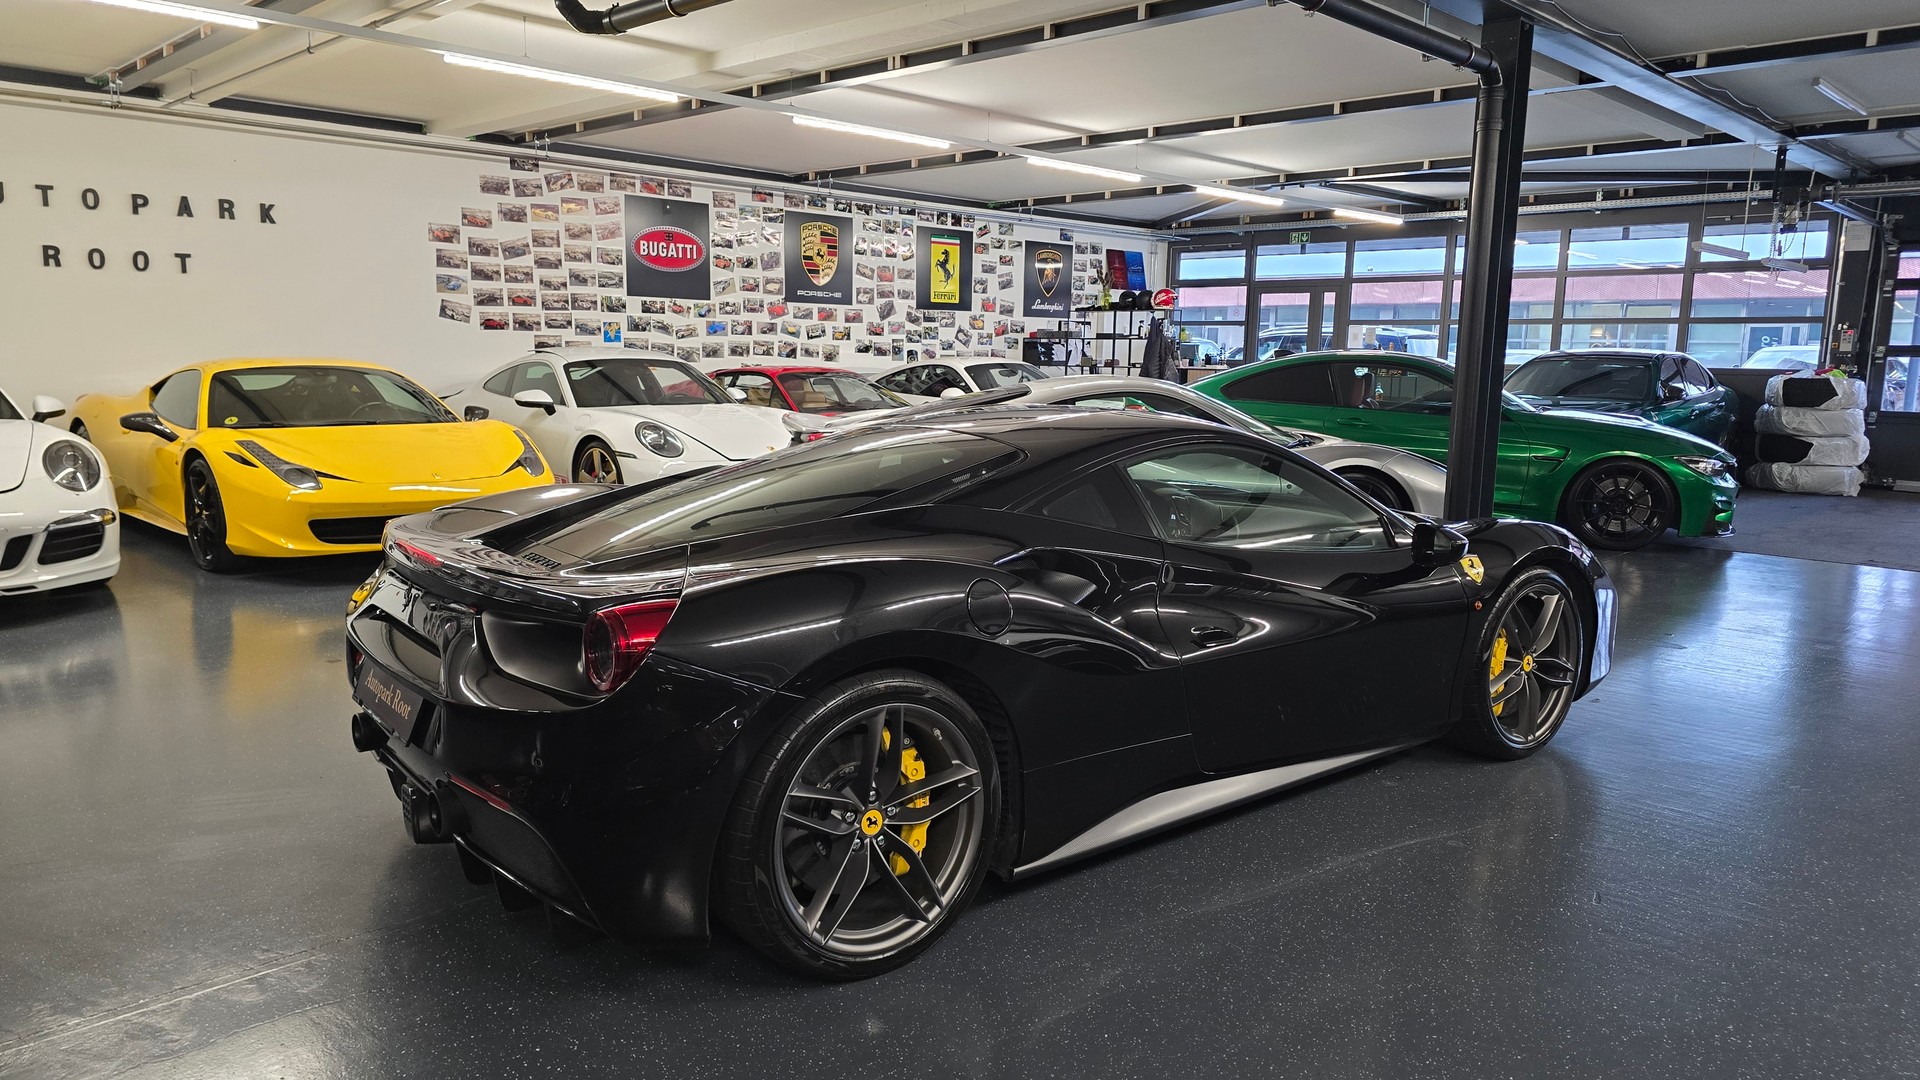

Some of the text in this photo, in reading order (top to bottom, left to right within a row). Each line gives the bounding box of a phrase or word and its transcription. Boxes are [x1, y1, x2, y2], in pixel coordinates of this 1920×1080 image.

[0, 181, 277, 224] TOPARK
[802, 224, 837, 235] PORSCHE
[640, 240, 697, 259] BUGATTI
[42, 245, 191, 273] ROOT
[797, 290, 842, 298] PORSCHE
[933, 291, 957, 301] Ferrari
[1031, 299, 1065, 312] Lamborghini
[364, 669, 412, 720] Autopark Root
